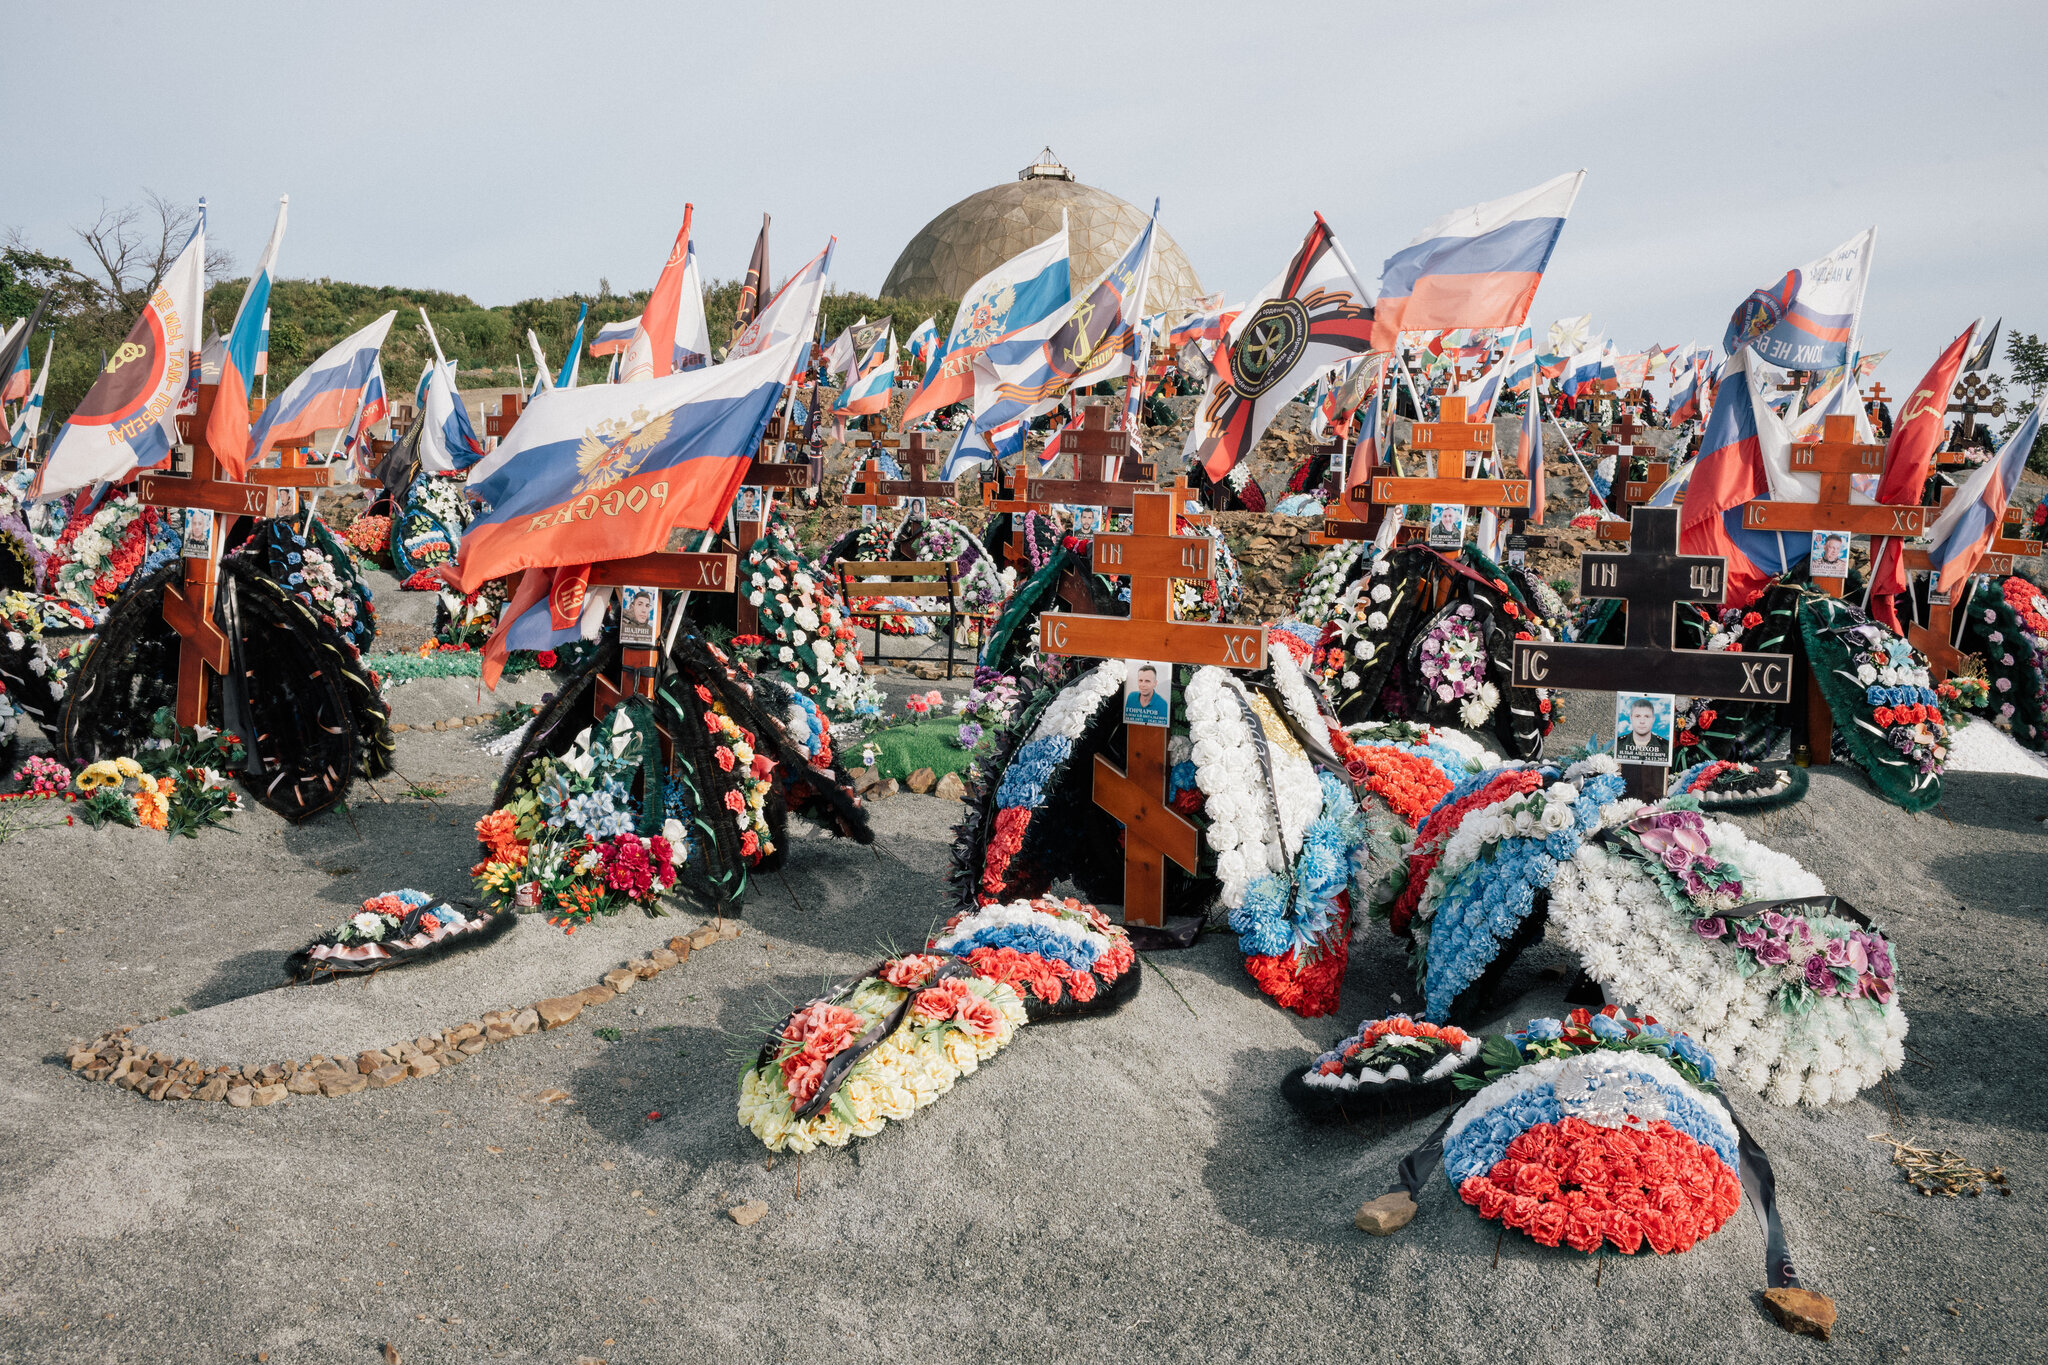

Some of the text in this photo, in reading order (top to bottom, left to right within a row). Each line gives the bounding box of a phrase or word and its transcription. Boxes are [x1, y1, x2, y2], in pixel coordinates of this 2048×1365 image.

[152, 287, 173, 313] ДЕ
[108, 392, 173, 446] ПОБЕДА!
[313, 470, 327, 485] ХС
[787, 468, 805, 485] ХС
[142, 479, 265, 512] ІС ХС
[881, 482, 954, 496] ІС ХС
[1030, 481, 1045, 499] ІС
[1378, 481, 1525, 503] ІС ХС
[1038, 503, 1049, 513] ХС
[1749, 505, 1919, 531] ІС ХС
[1327, 522, 1339, 536] ІС
[1599, 523, 1611, 538] ІС
[2024, 542, 2040, 554] ХС
[1101, 543, 1204, 575] ІН ЦІ
[1988, 557, 2010, 572] ХС
[696, 560, 724, 586] ХС
[1591, 562, 1721, 598] ІН ЦІ
[1047, 619, 1257, 664] ІС ХС
[1521, 648, 1783, 695] ІС ХС
[1125, 707, 1159, 716] ГОНЧАРОВ
[1625, 744, 1660, 753] ГОРОХОВ
